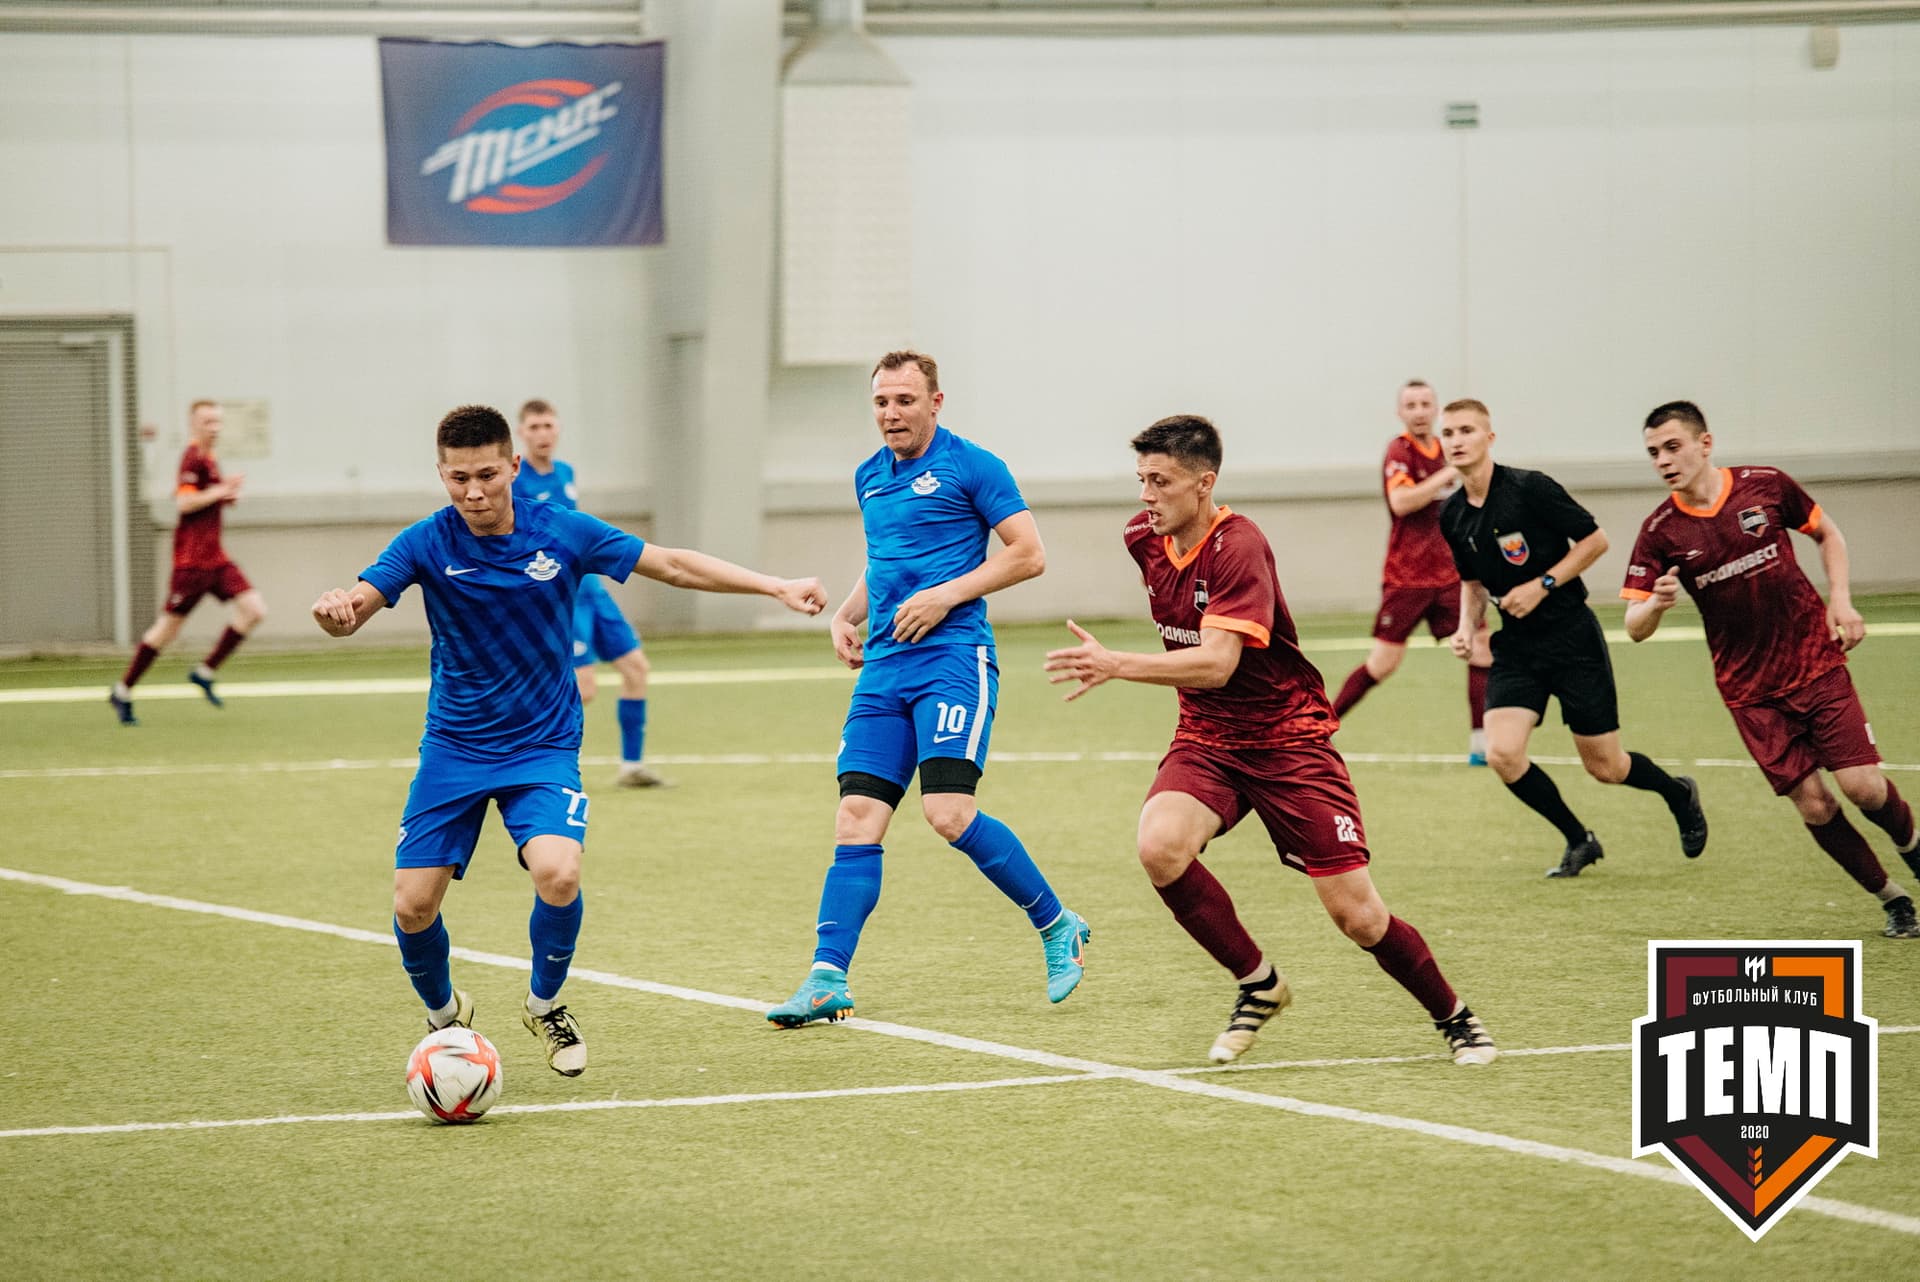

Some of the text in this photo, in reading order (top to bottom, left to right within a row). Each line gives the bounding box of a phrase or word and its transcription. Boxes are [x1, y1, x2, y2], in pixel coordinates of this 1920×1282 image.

[1155, 622, 1201, 646] ОДИНВ
[937, 702, 967, 733] 10
[1334, 815, 1359, 842] 22
